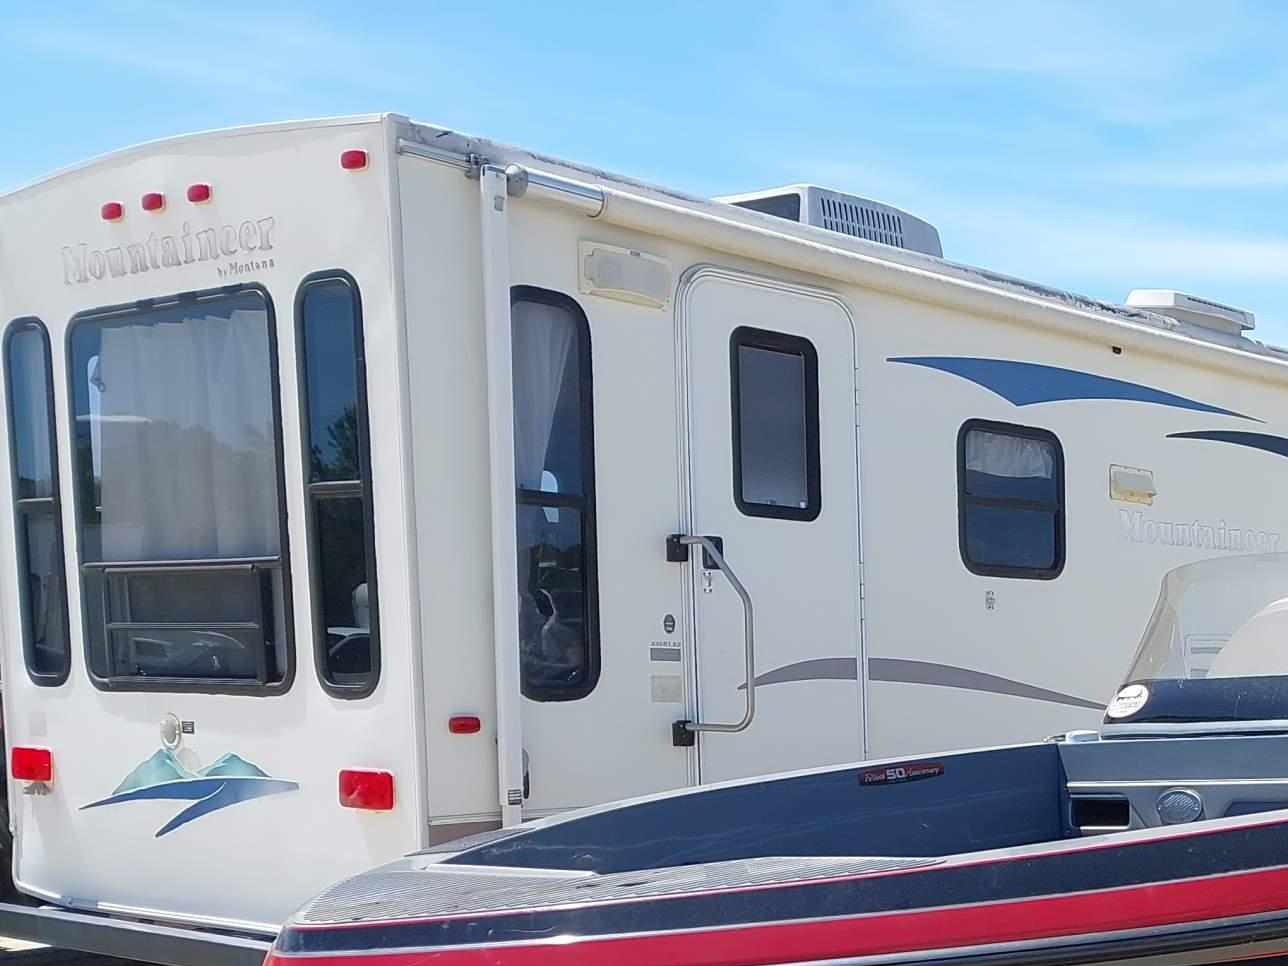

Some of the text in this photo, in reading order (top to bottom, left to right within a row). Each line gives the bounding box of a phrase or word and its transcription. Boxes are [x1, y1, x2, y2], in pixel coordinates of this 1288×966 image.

[60, 216, 275, 286] Mountaineer
[228, 258, 275, 275] Montana
[1118, 508, 1281, 558] Mountaineer
[886, 767, 905, 779] 50
